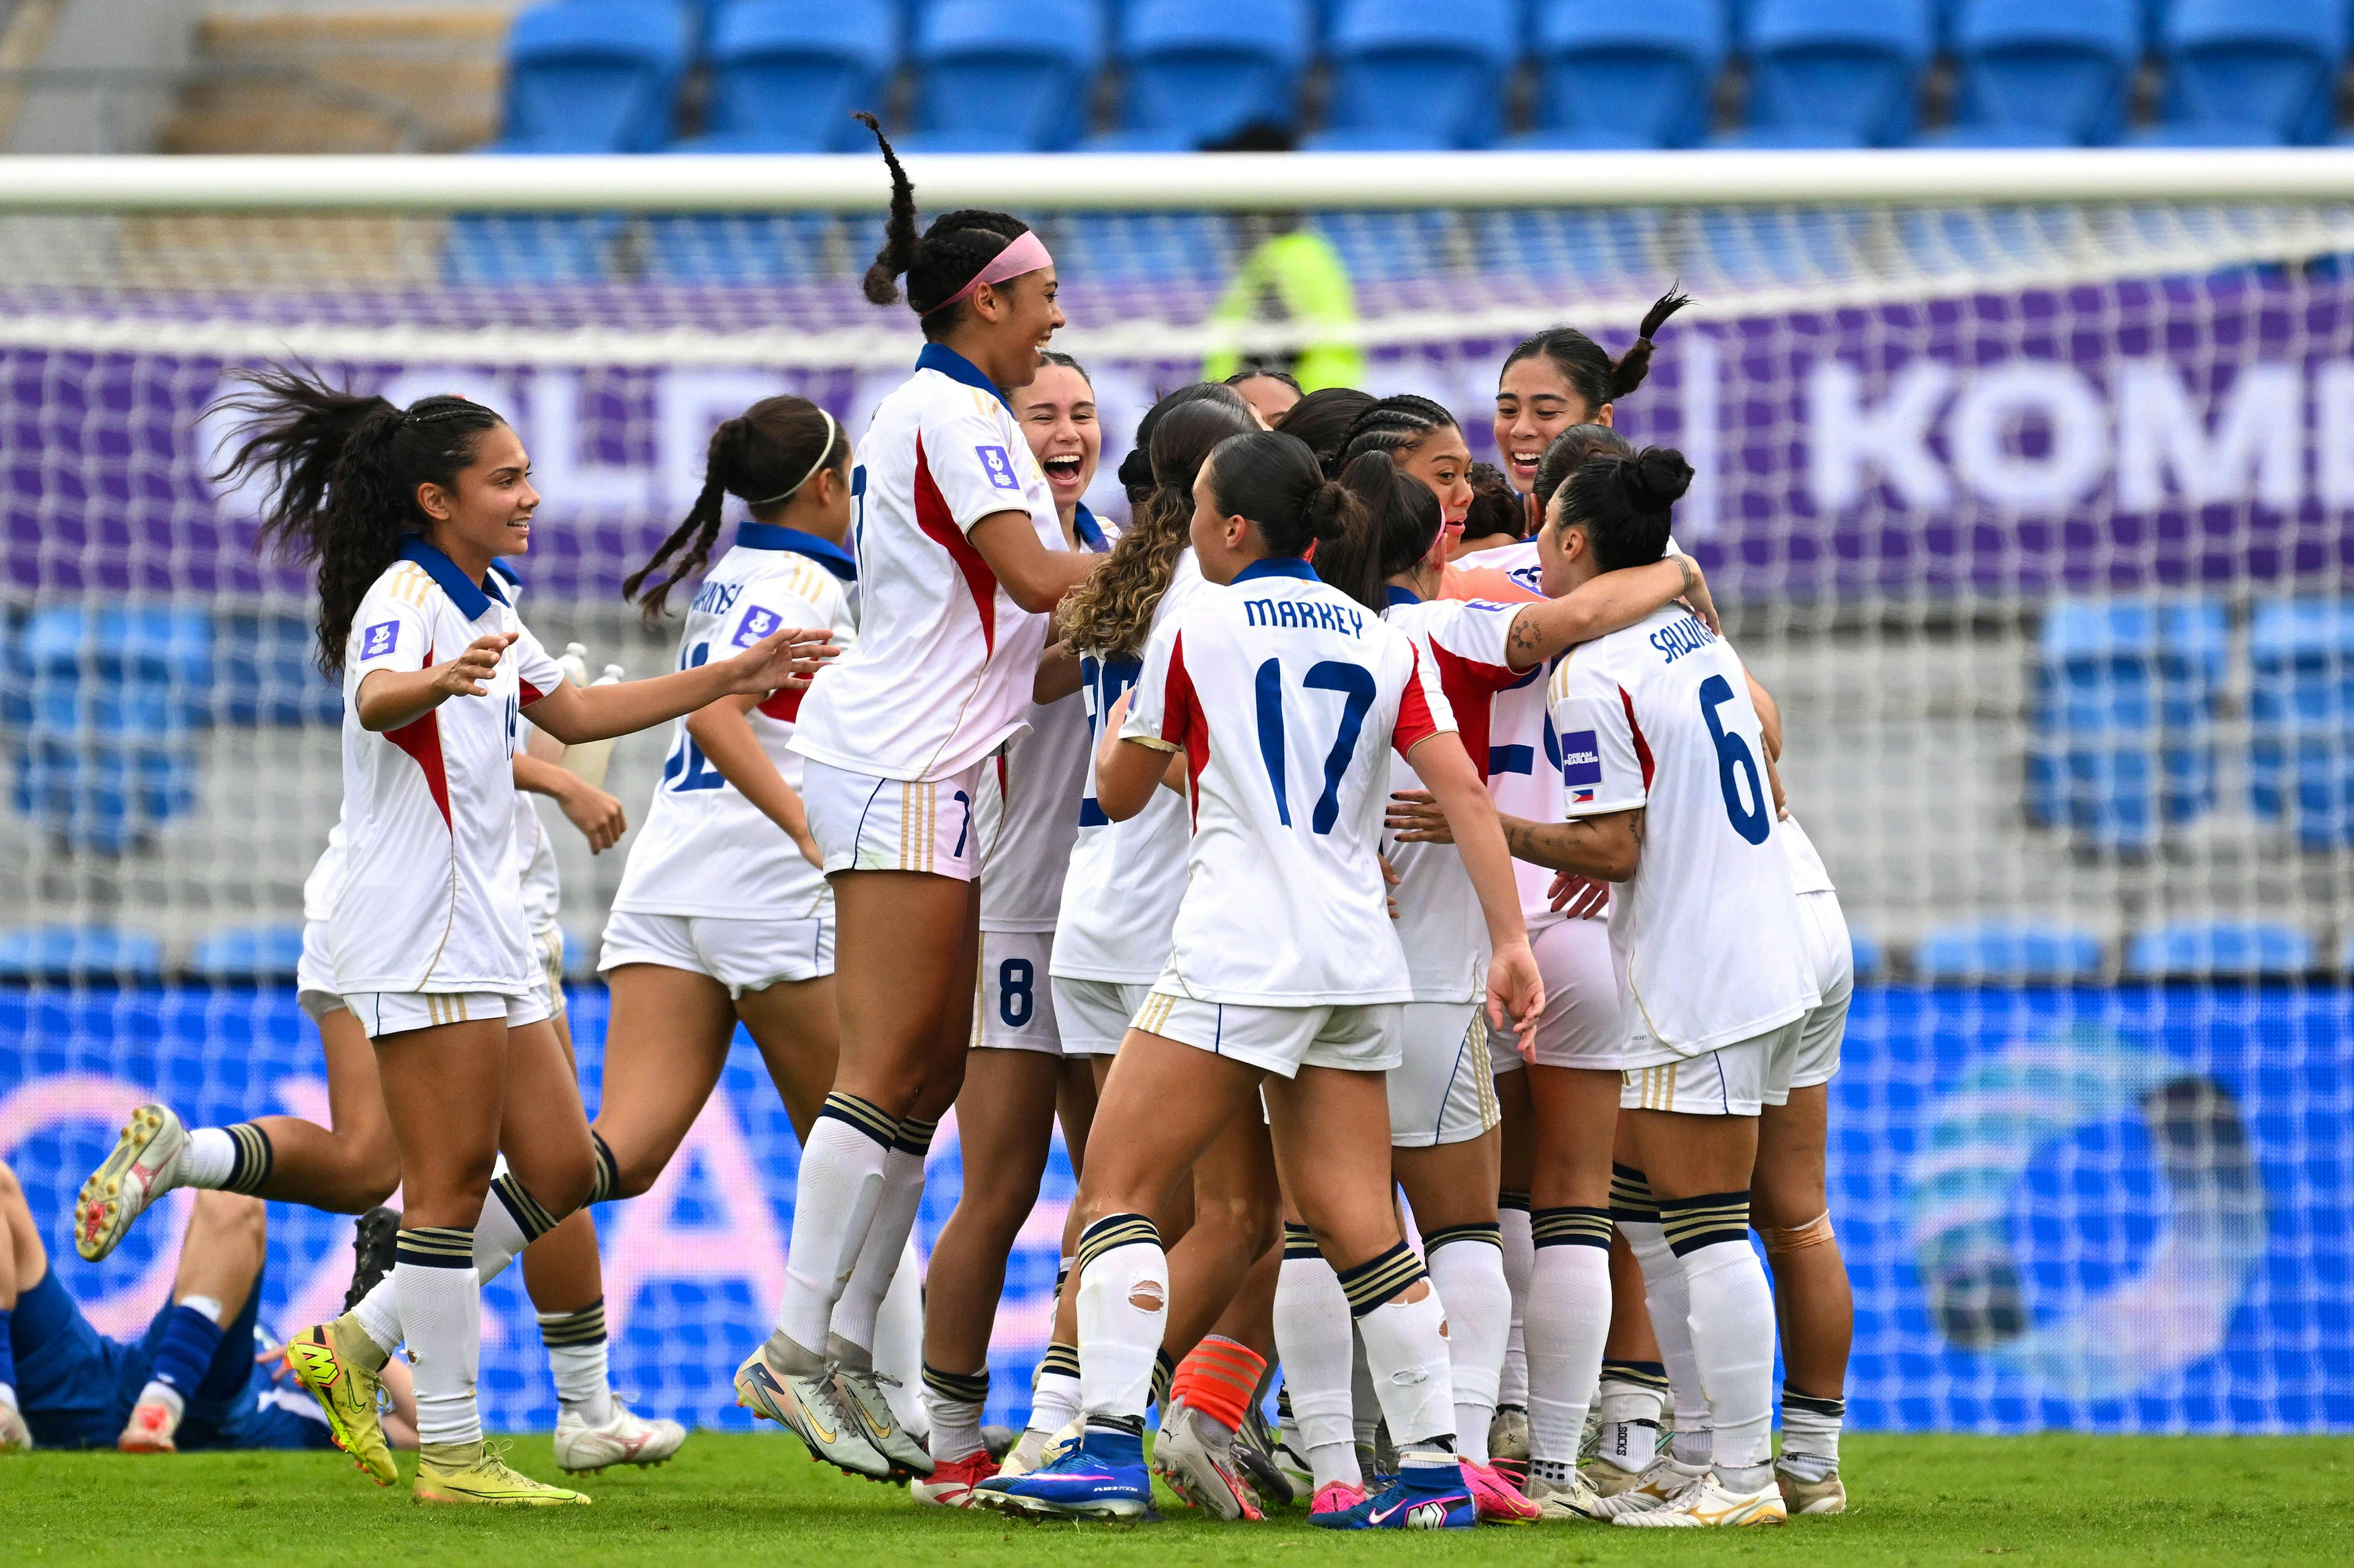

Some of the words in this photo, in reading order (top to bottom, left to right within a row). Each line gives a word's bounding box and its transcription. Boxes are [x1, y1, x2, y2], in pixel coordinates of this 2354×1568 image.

[1244, 599, 1363, 639] MARKEY
[1255, 657, 1377, 835] 17
[1564, 756, 1599, 766] FEARLESS
[1567, 751, 1593, 759] DREAM
[1699, 674, 1770, 845] 6
[953, 790, 970, 858] 7
[999, 958, 1034, 1027] 8
